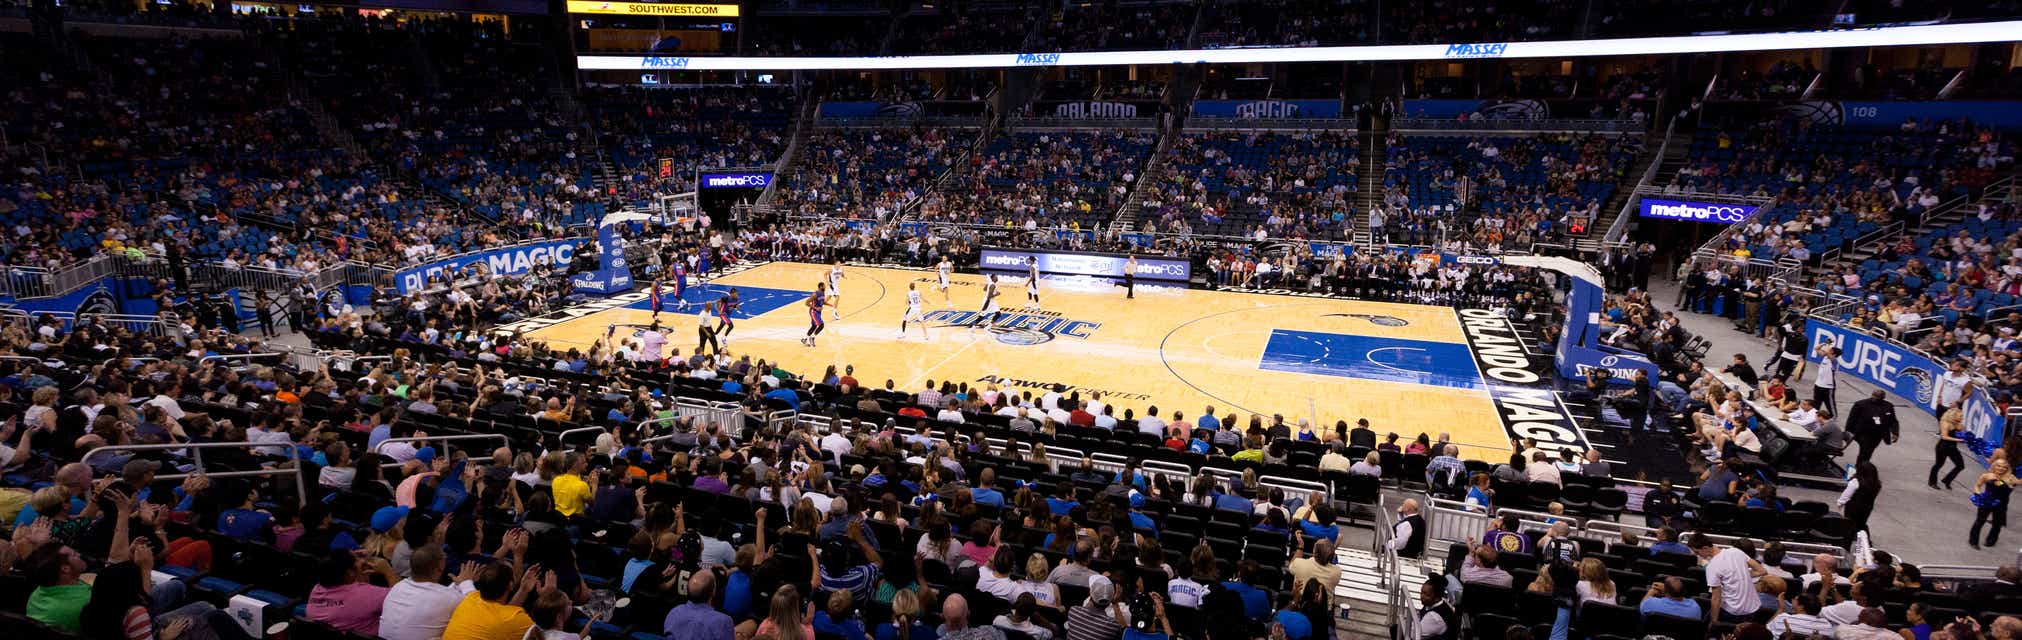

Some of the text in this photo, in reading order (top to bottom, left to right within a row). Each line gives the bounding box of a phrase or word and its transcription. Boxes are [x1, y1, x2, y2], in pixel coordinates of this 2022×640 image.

[629, 4, 718, 14] SOUTHWEST.COM
[1445, 44, 1508, 55] MASSEY
[641, 57, 689, 67] MASSEY
[1016, 53, 1060, 64] MASSEY
[1852, 107, 1877, 118] 108
[709, 174, 766, 186] metroPCS
[1650, 204, 1745, 222] metroPCS
[488, 244, 574, 277] MAGIC
[985, 255, 1038, 267] metroPC
[1456, 256, 1493, 265] GEICO
[1136, 264, 1184, 276] etroPCS
[574, 279, 605, 291] SPALDING
[1459, 308, 1540, 384] ORLANDO
[1811, 327, 1902, 389] PURE
[1575, 363, 1640, 379] SDIN
